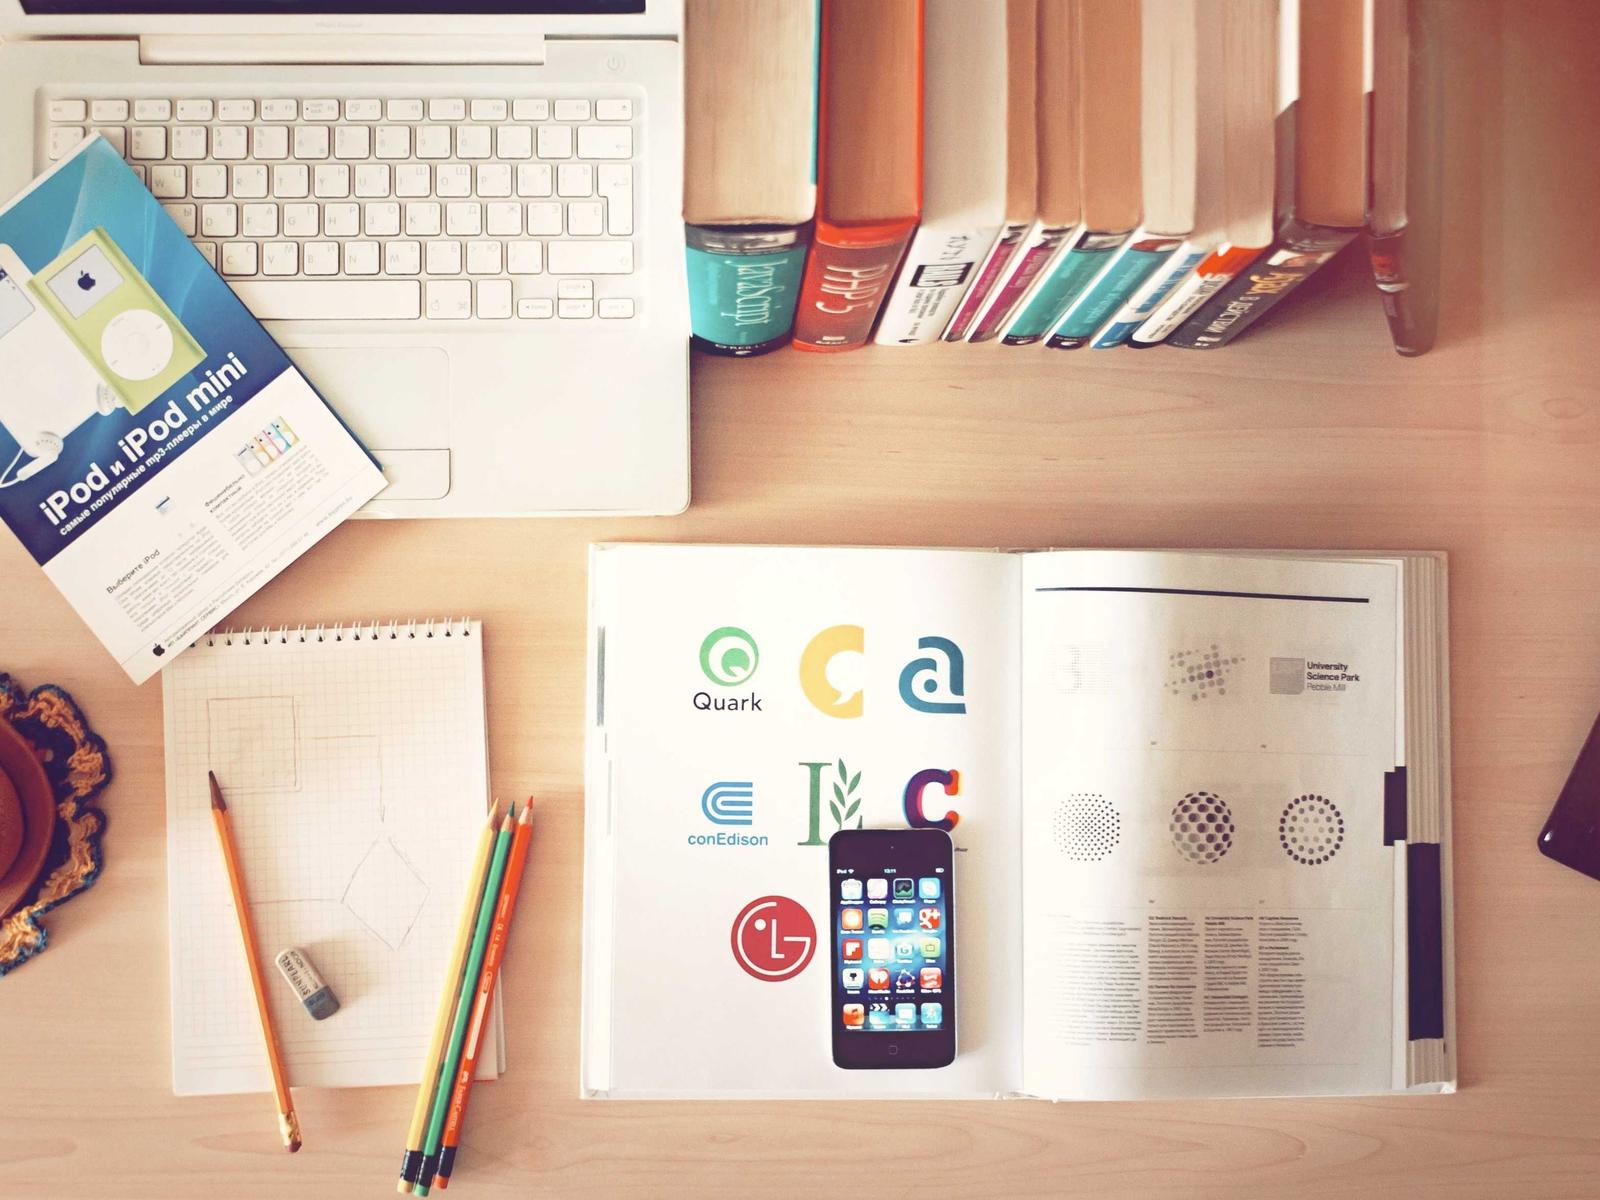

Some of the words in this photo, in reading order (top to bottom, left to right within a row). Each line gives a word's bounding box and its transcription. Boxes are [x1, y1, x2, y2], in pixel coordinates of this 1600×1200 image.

[720, 258, 789, 327] JavaScript
[820, 264, 890, 300] PHP
[815, 300, 874, 314] 5
[186, 351, 248, 412] mini
[117, 400, 189, 463] iPod
[60, 508, 91, 537] самые
[90, 464, 146, 513] популярные
[208, 394, 234, 418] мире
[109, 460, 126, 477] и
[39, 462, 111, 526] iPod
[106, 561, 144, 594] Выберите
[143, 549, 161, 568] iPod
[1306, 662, 1349, 672] University
[1306, 672, 1339, 680] Science
[1341, 673, 1360, 682] Park
[693, 691, 763, 712] Quark
[687, 832, 769, 847] conEdison
